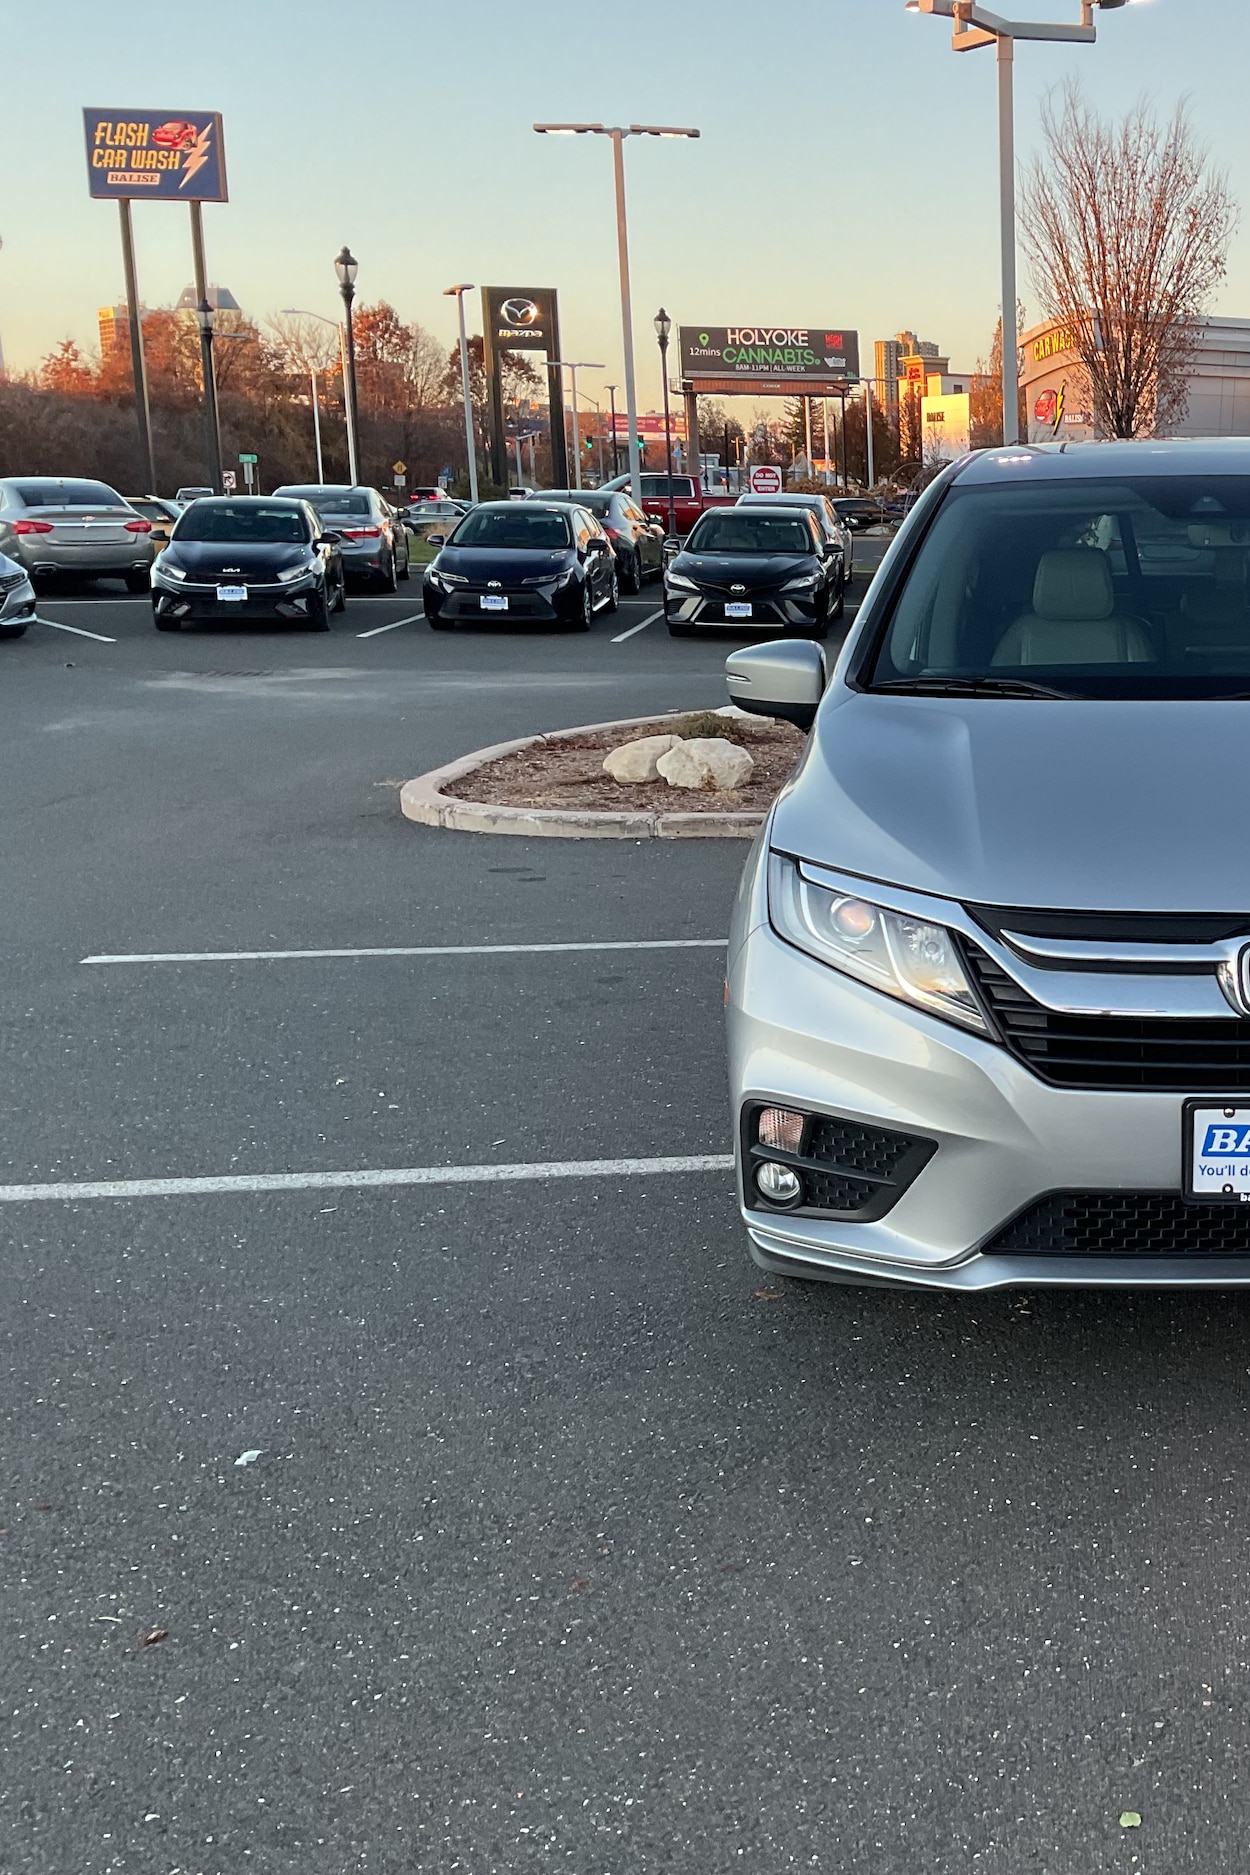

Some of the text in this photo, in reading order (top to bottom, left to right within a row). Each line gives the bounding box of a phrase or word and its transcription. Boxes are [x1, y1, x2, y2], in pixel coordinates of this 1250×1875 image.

[95, 122, 149, 146] FLASH
[92, 148, 181, 169] CAR WASH
[110, 173, 158, 183] BALISE
[727, 329, 809, 346] HOLYOKE
[689, 347, 721, 357] 12mins
[1033, 336, 1051, 361] CAR
[735, 363, 806, 372] 8AM-11PM ALL-WEEK
[1064, 414, 1086, 424] BALIS
[1198, 1164, 1236, 1177] You'll
